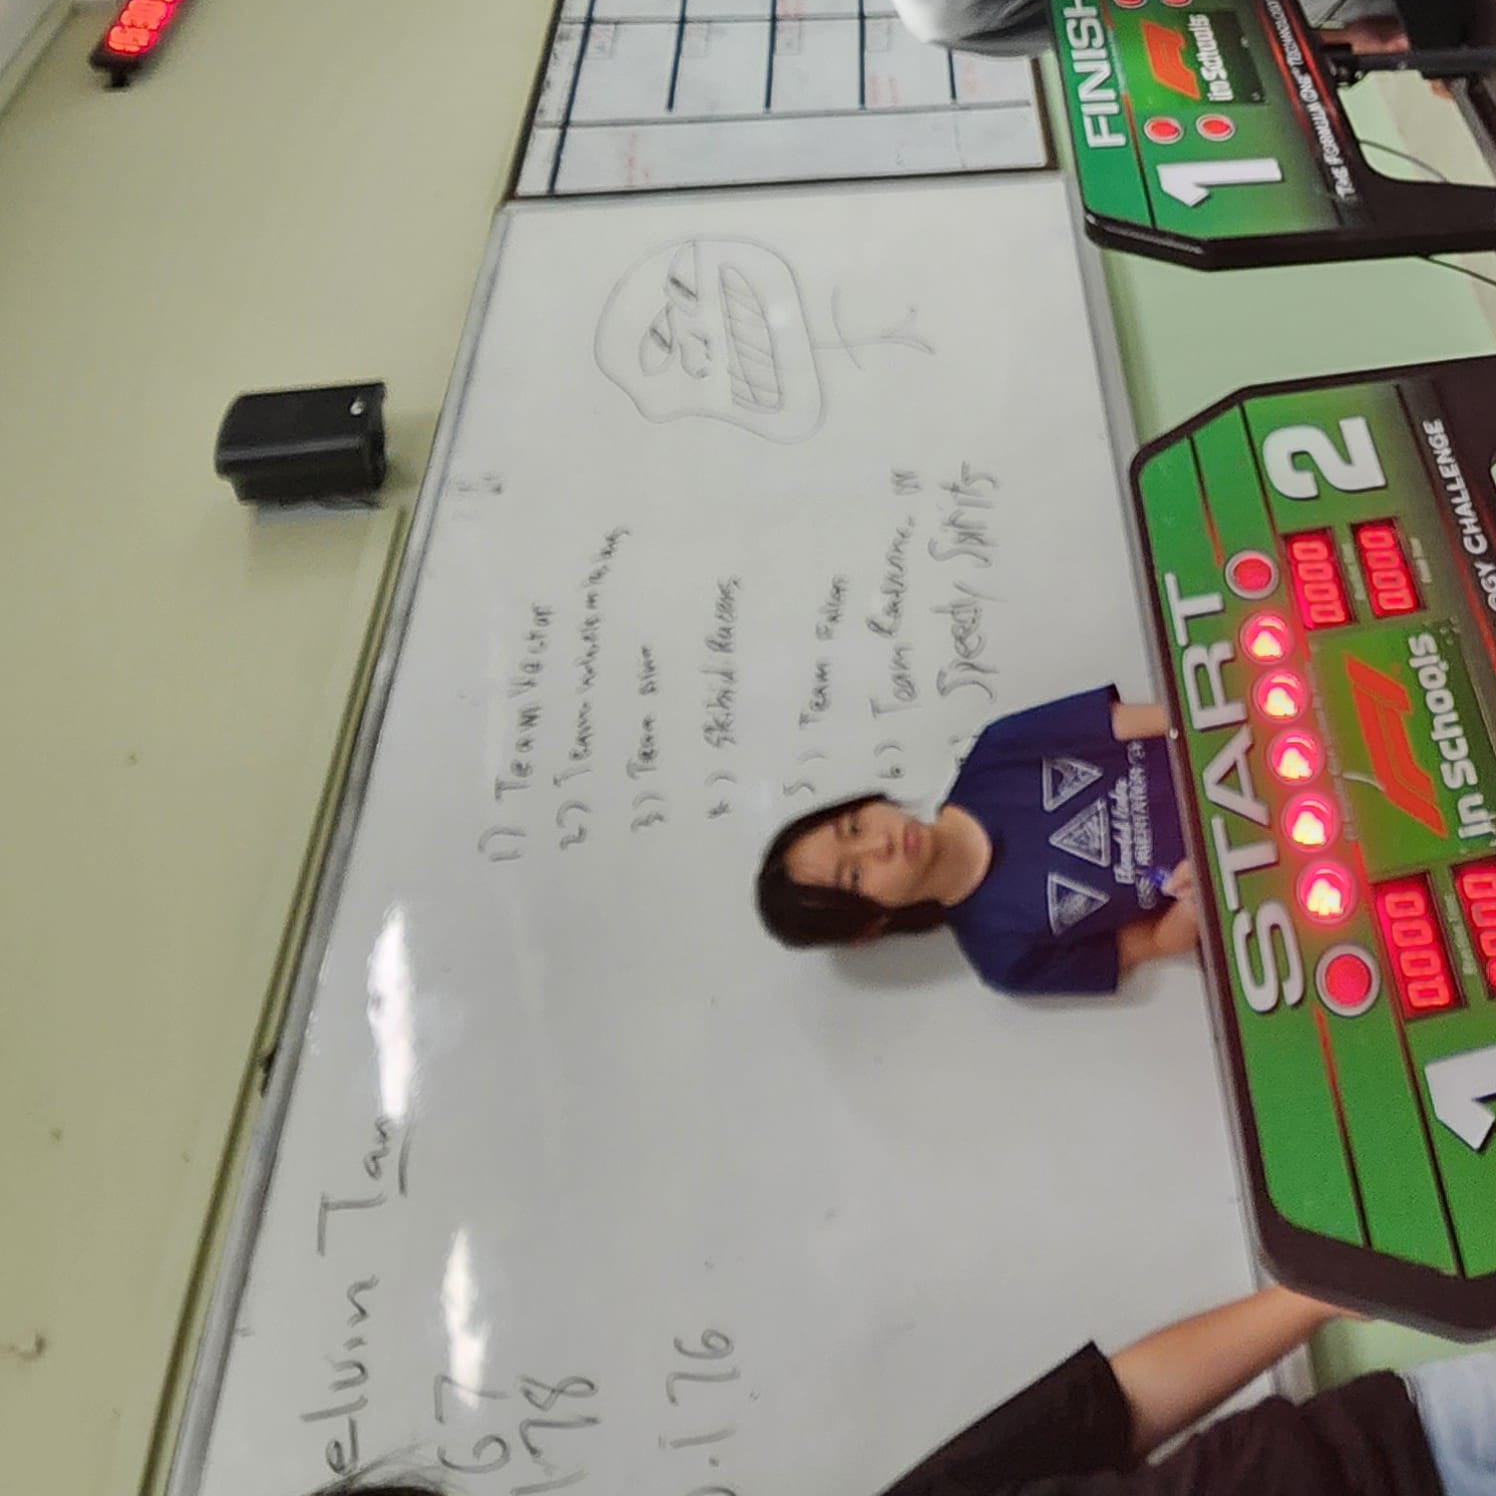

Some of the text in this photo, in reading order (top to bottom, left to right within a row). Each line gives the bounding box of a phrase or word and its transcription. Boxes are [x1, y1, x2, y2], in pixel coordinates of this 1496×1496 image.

[1187, 14, 1227, 81] Schools
[1156, 158, 1283, 208] 1
[1332, 166, 1355, 198] THE
[1262, 416, 1387, 498] 2
[1422, 418, 1488, 555] CHALLENGE
[866, 643, 923, 720] Team
[929, 579, 1008, 703] Speedy
[797, 659, 832, 729] Team
[1408, 634, 1478, 789] Schools
[493, 704, 543, 804] Team
[1164, 572, 1305, 1013] START
[1384, 891, 1450, 1008] 0.000
[298, 1274, 379, 1478] elvin
